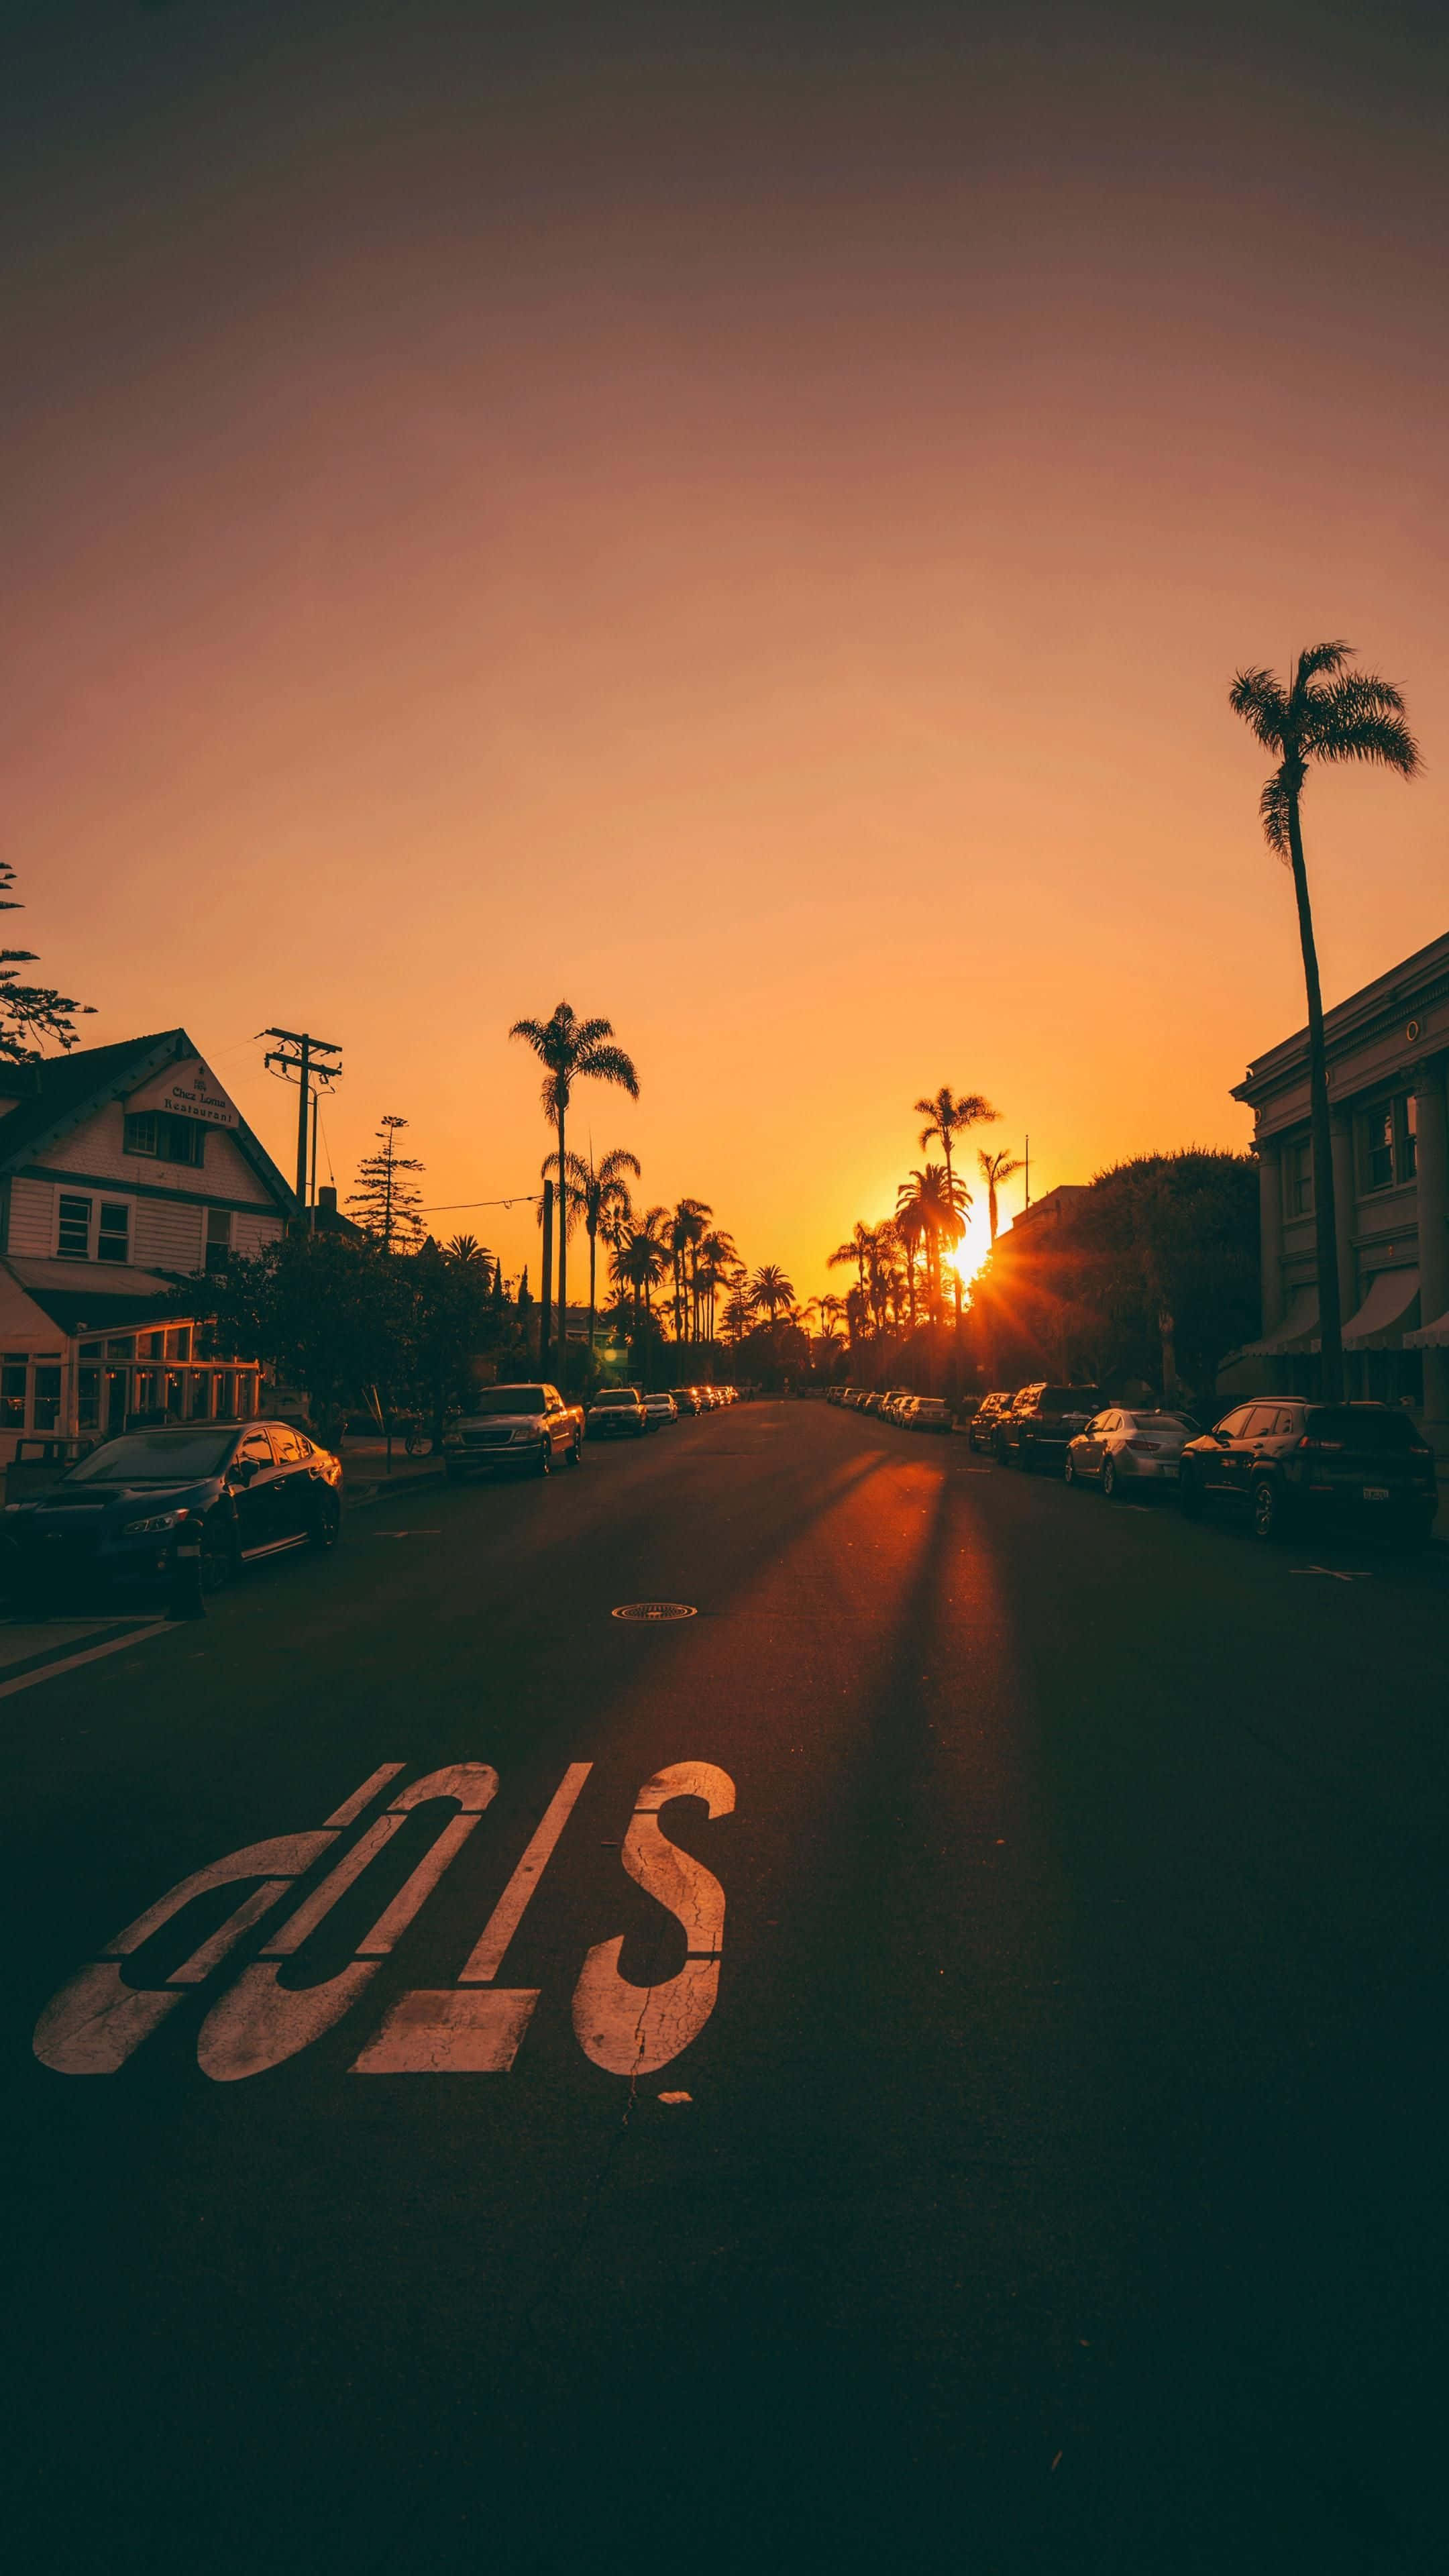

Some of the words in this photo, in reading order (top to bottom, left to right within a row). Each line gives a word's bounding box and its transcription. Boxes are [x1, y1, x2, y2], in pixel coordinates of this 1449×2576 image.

[172, 1086, 196, 1101] Chez
[200, 1093, 225, 1108] Loma
[164, 1098, 232, 1122] Restaurant
[32, 1760, 736, 2081] STOP
